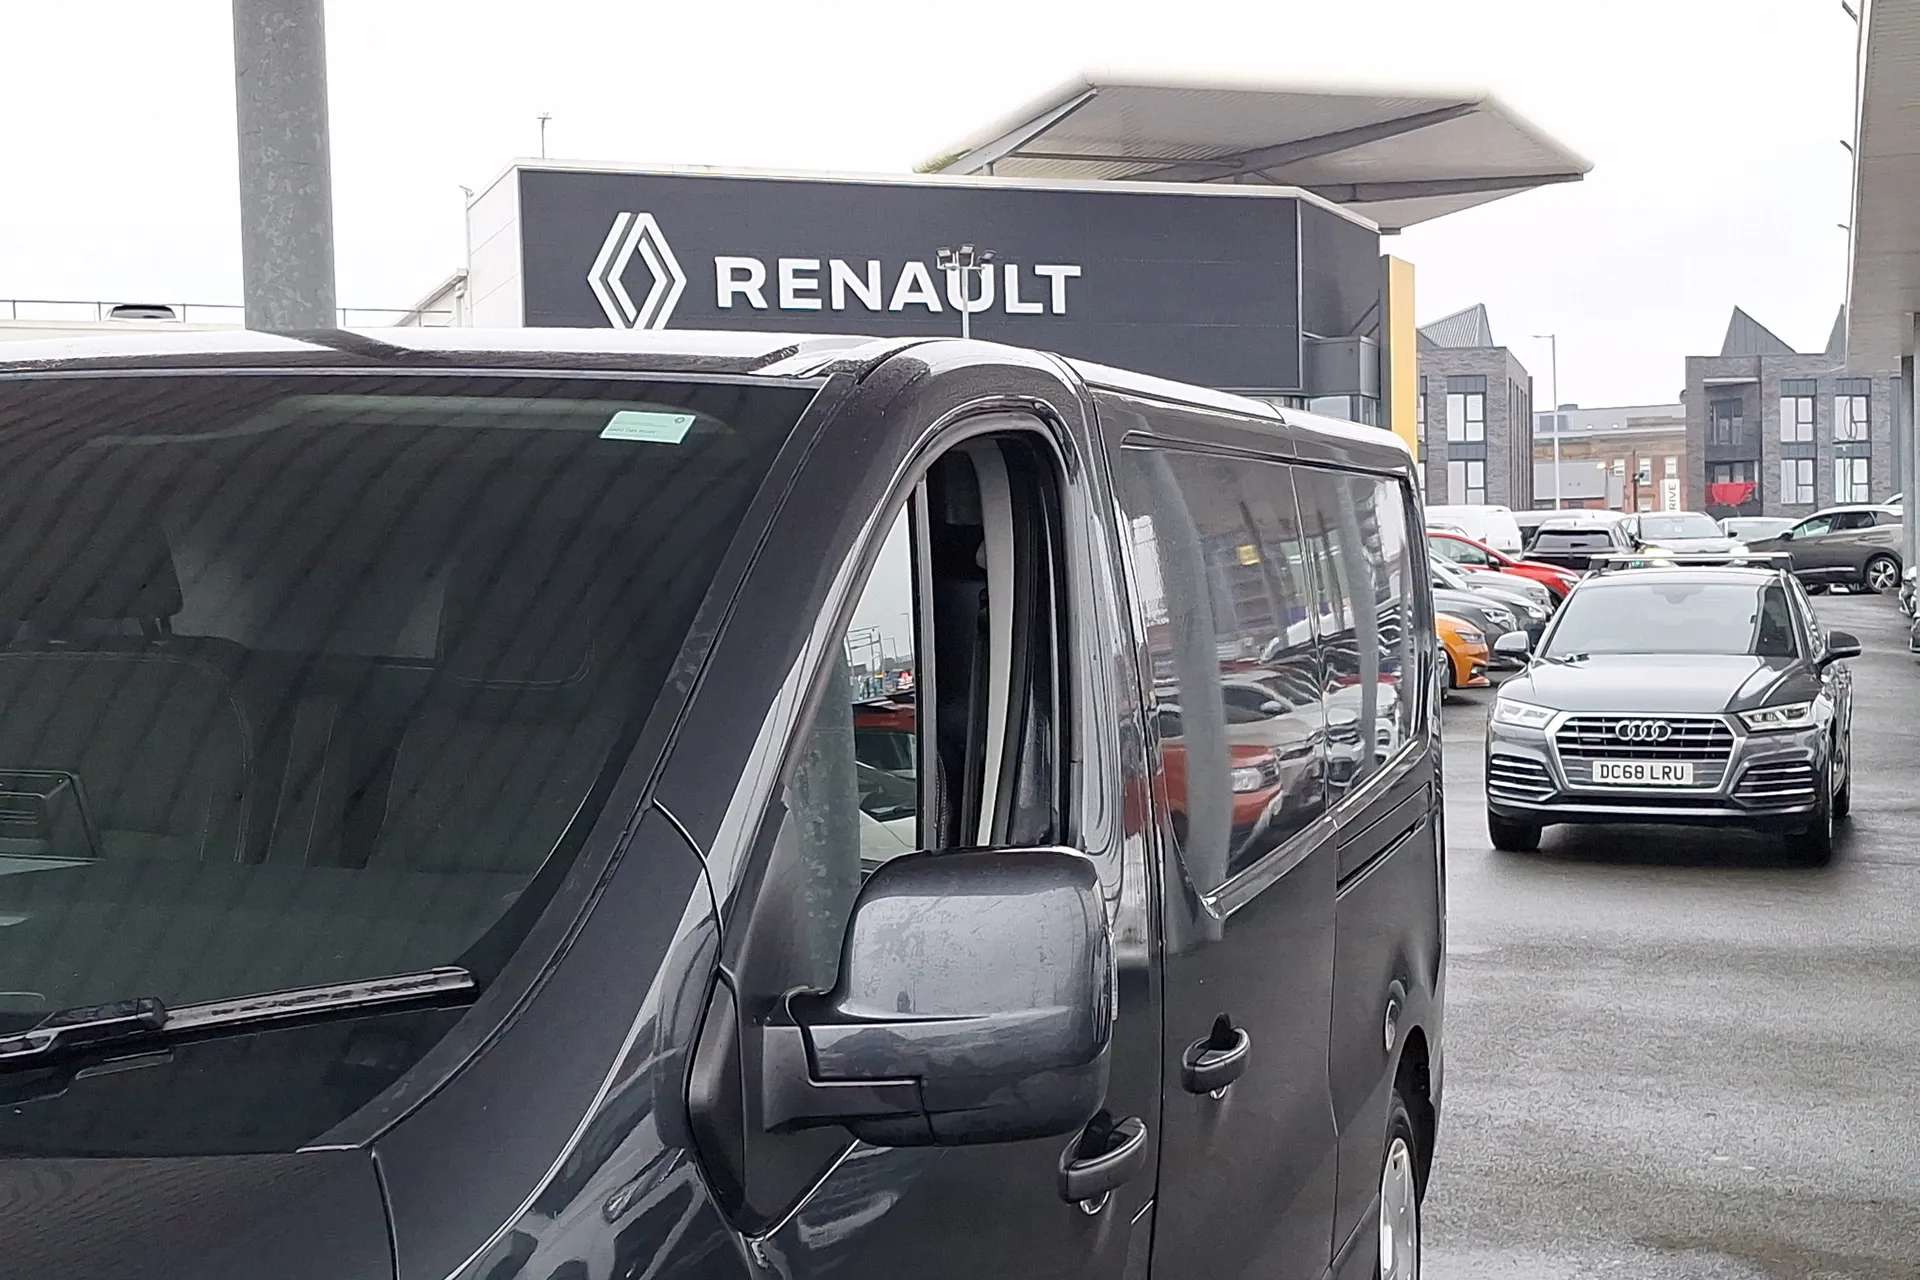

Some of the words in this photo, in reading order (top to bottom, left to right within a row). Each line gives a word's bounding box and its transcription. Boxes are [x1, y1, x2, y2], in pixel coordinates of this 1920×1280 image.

[714, 256, 1082, 315] RENAULT
[1600, 764, 1645, 780] DC68
[1650, 765, 1685, 781] LRU
